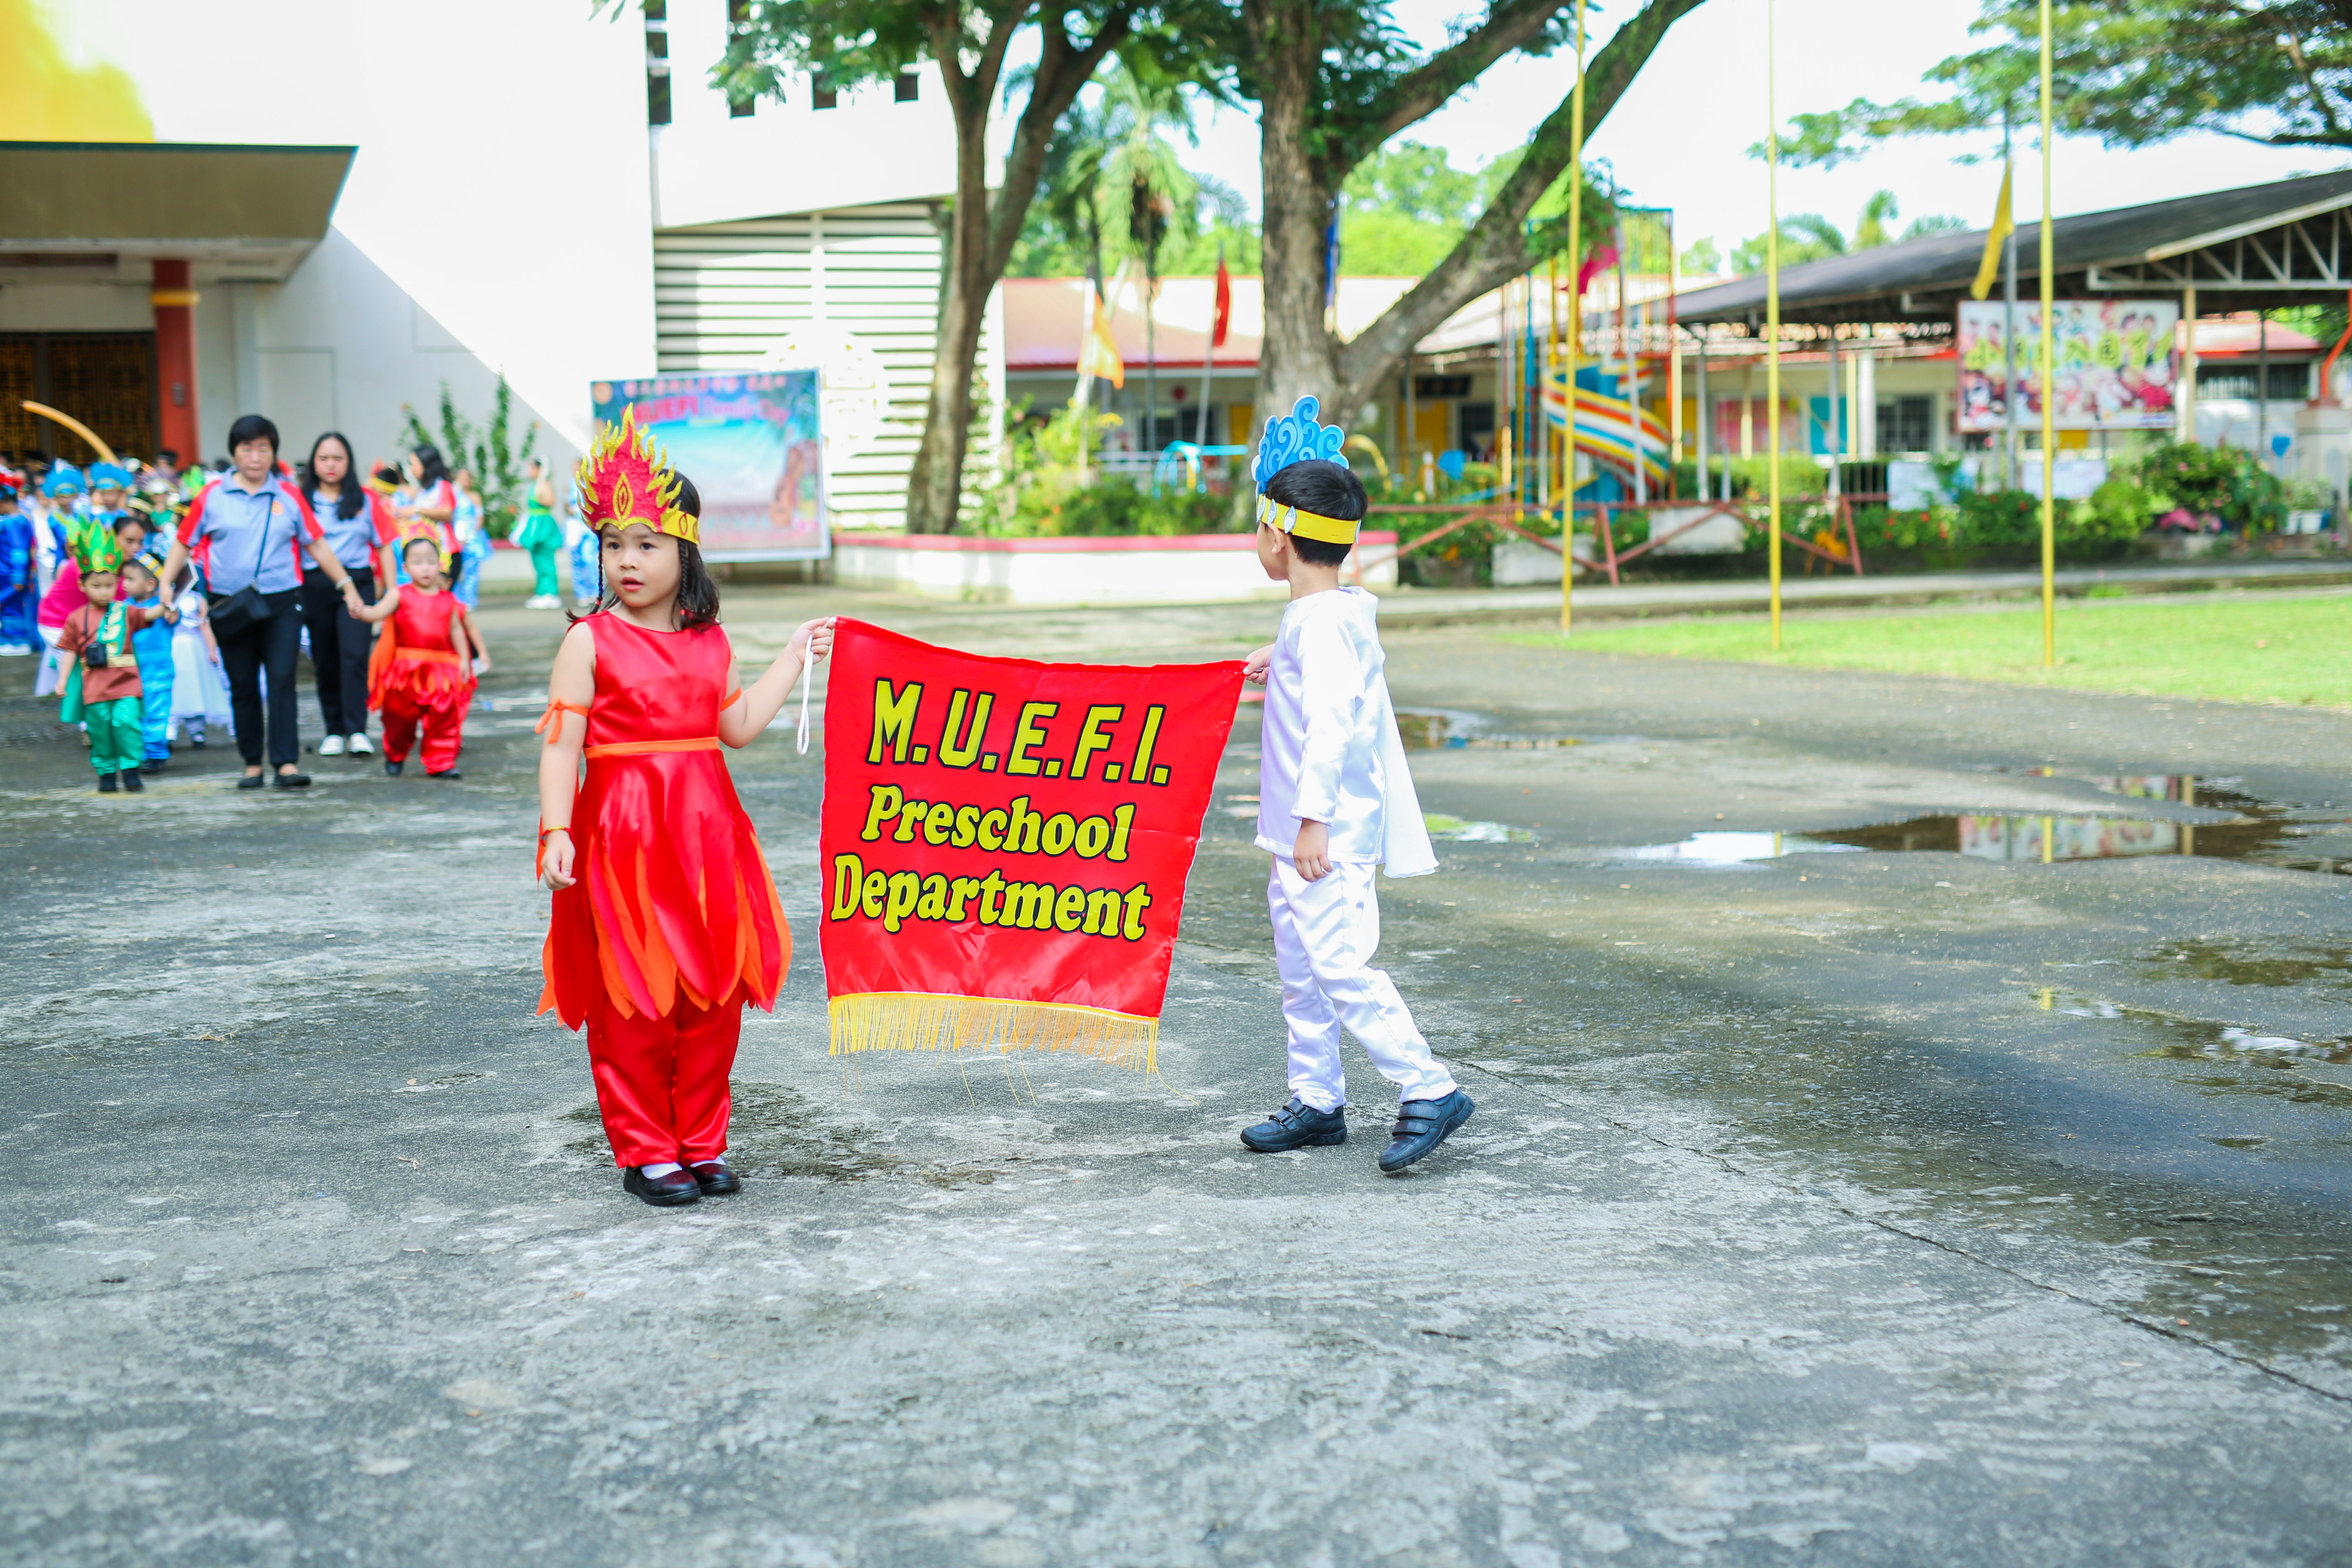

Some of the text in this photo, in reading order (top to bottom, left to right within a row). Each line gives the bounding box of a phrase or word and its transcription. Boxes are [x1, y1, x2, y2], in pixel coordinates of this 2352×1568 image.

[866, 678, 1172, 786] M.U.E.F.I.
[860, 783, 1136, 863] Preschool
[830, 853, 1152, 942] Department
